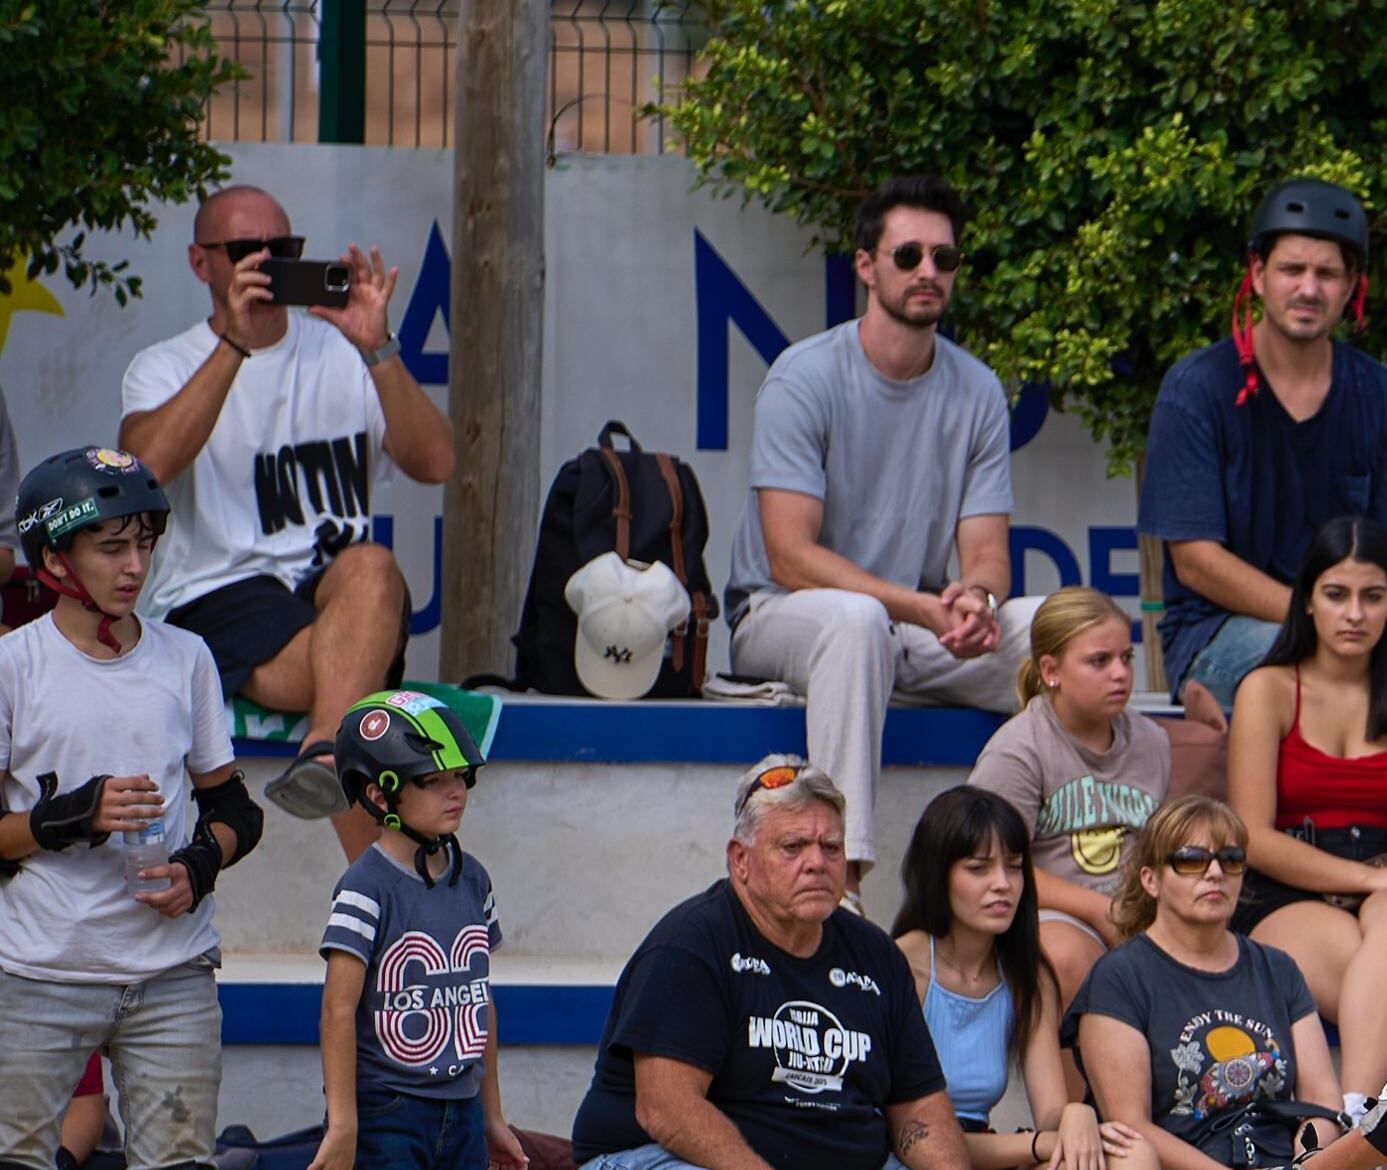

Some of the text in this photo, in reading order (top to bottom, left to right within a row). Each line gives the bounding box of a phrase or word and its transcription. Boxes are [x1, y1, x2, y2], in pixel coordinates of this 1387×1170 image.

[69, 507, 82, 520] DO
[383, 989, 425, 1011] LOS
[748, 1016, 872, 1062] WORLD CUP
[1180, 1009, 1274, 1043] ENJOY THE SUN
